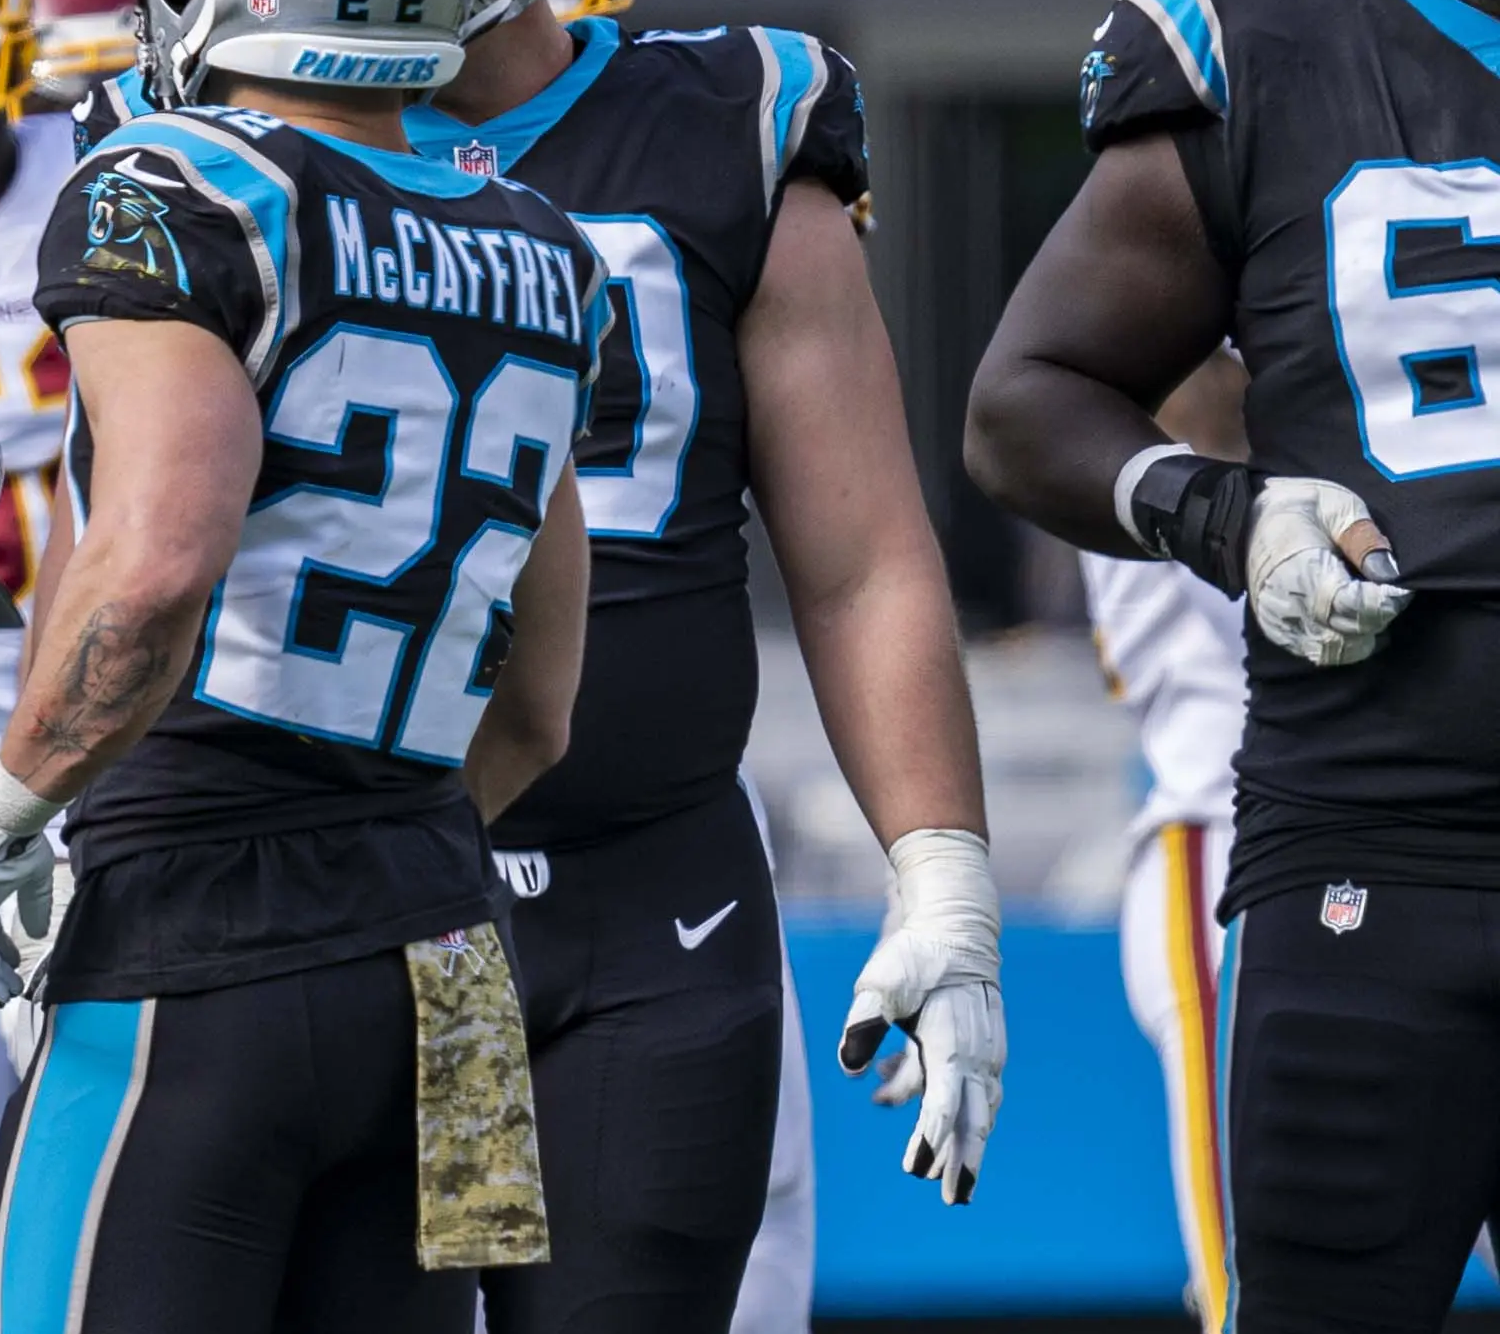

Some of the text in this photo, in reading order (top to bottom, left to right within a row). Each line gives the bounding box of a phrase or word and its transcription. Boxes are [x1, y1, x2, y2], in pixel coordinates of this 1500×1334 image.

[291, 47, 440, 83] PANTHERS
[326, 194, 583, 346] McCAFFREY
[193, 321, 579, 768] 22
